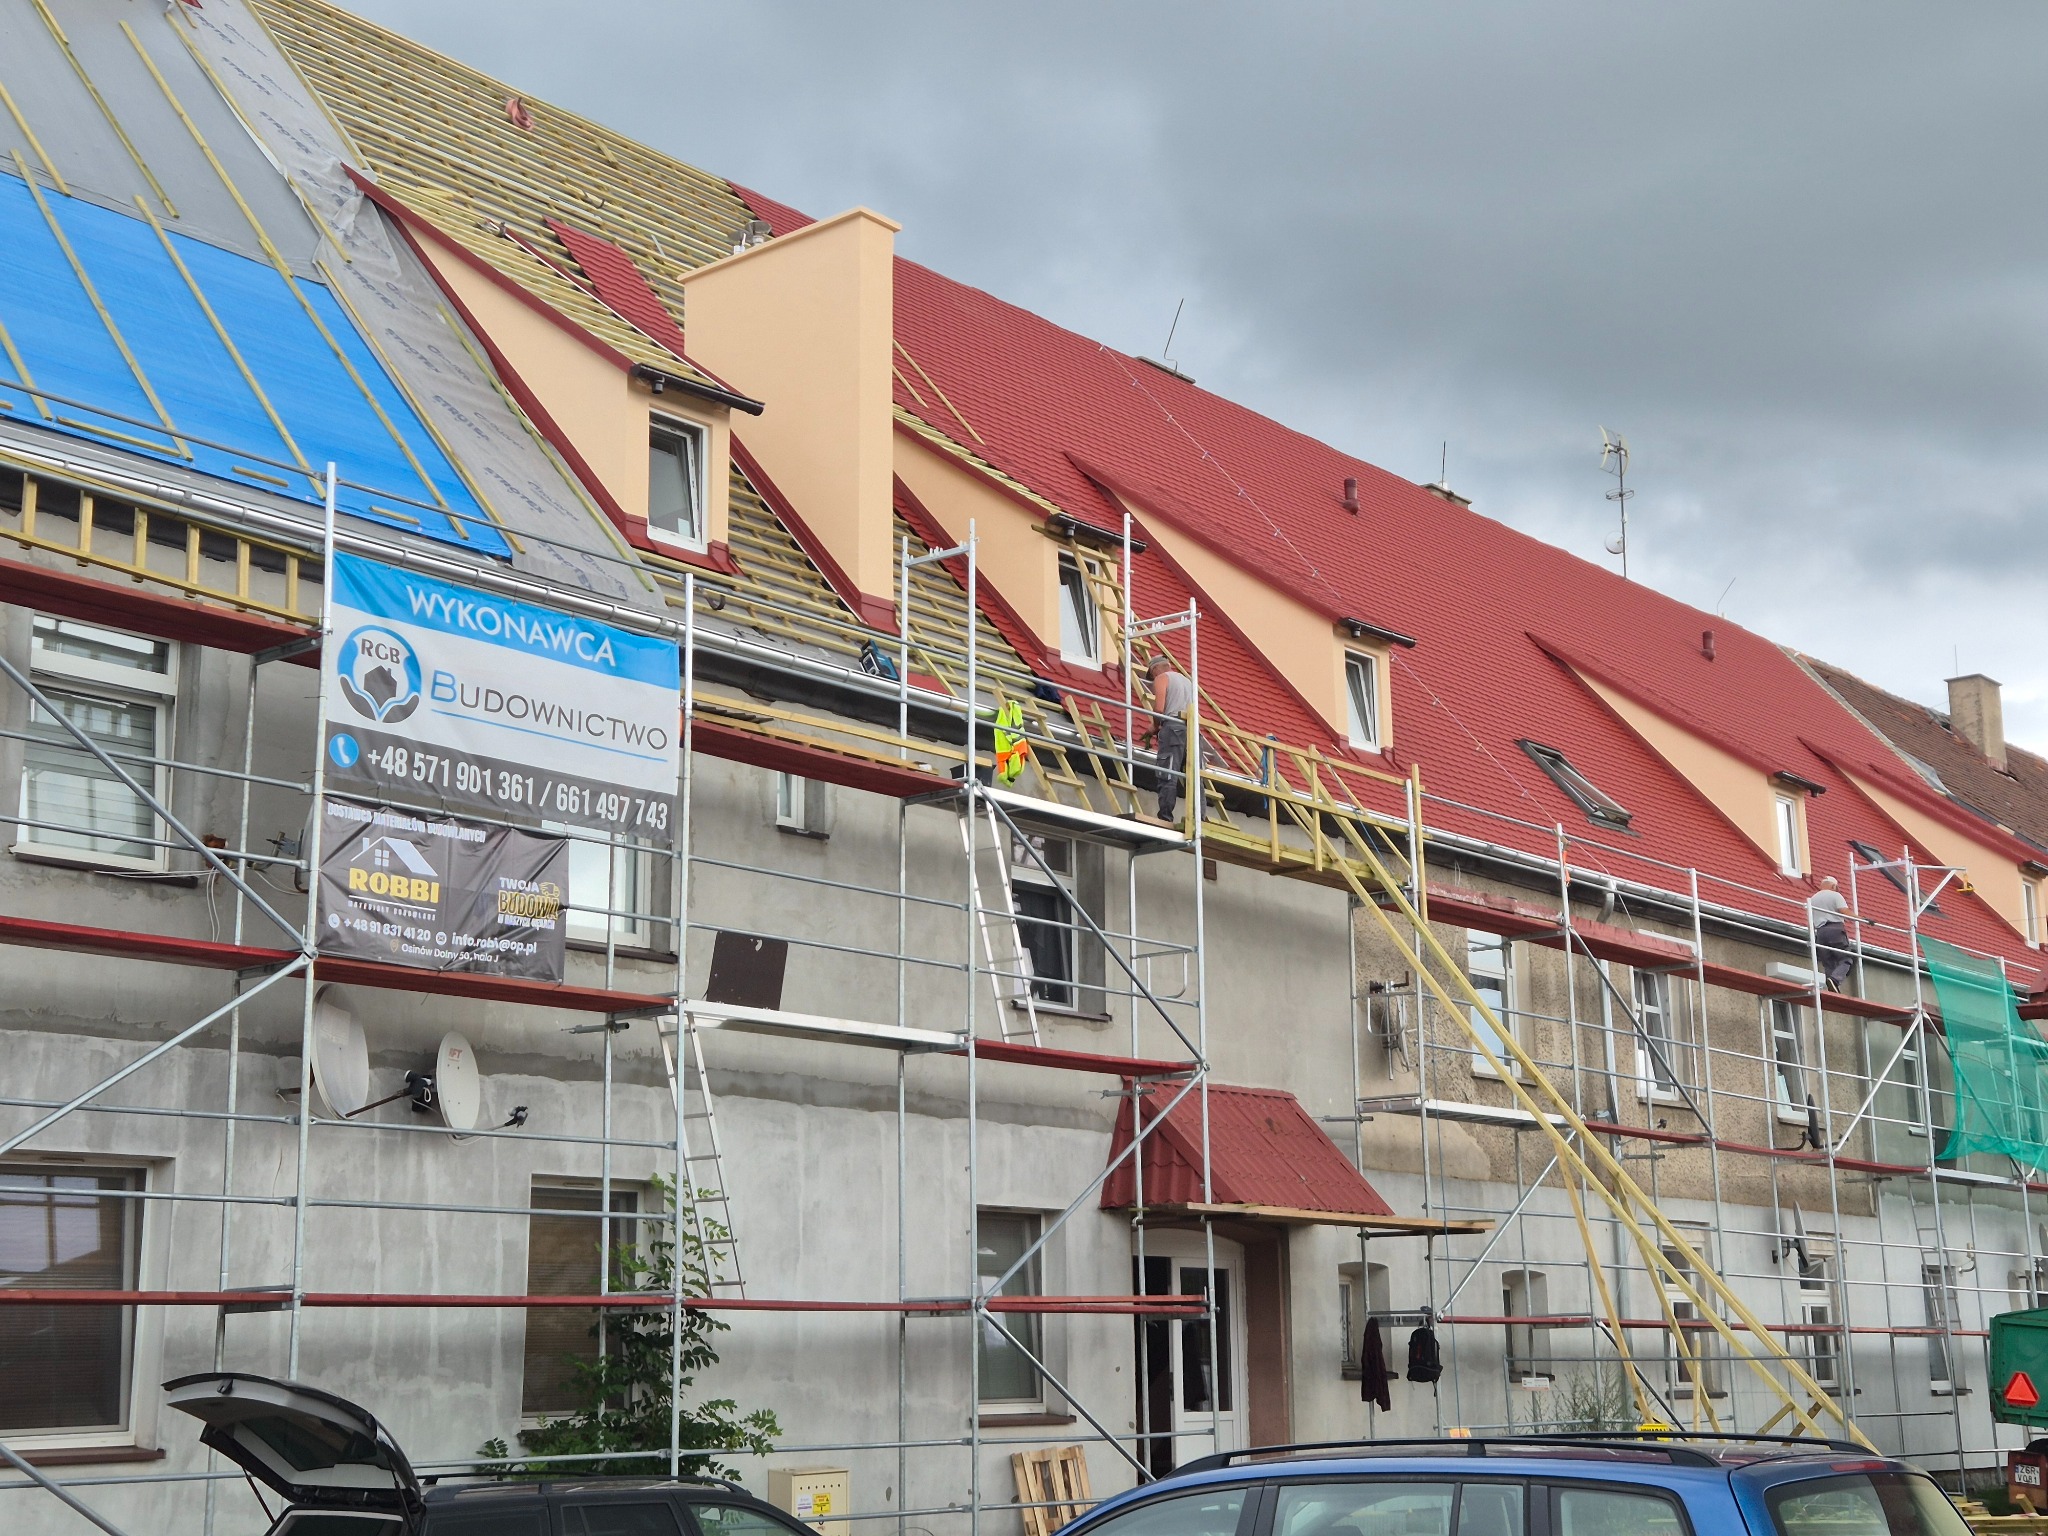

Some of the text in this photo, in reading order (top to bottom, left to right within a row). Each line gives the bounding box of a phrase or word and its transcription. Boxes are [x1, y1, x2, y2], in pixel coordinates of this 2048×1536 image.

[484, 466, 546, 515] STROTEX
[406, 585, 616, 667] WYKONAWCA
[361, 638, 401, 665] RGB
[430, 669, 668, 750] BUDOWNICTWO
[367, 745, 668, 830] +48 571 901 361 / 661 497 743
[349, 868, 439, 903] ROBBI
[500, 877, 539, 892] TWOJA
[498, 890, 559, 920] BUDOWA
[353, 918, 368, 931] 48
[370, 920, 380, 934] 91
[383, 923, 401, 936] 831
[401, 943, 433, 956] Osinów
[434, 948, 458, 960] Dolny
